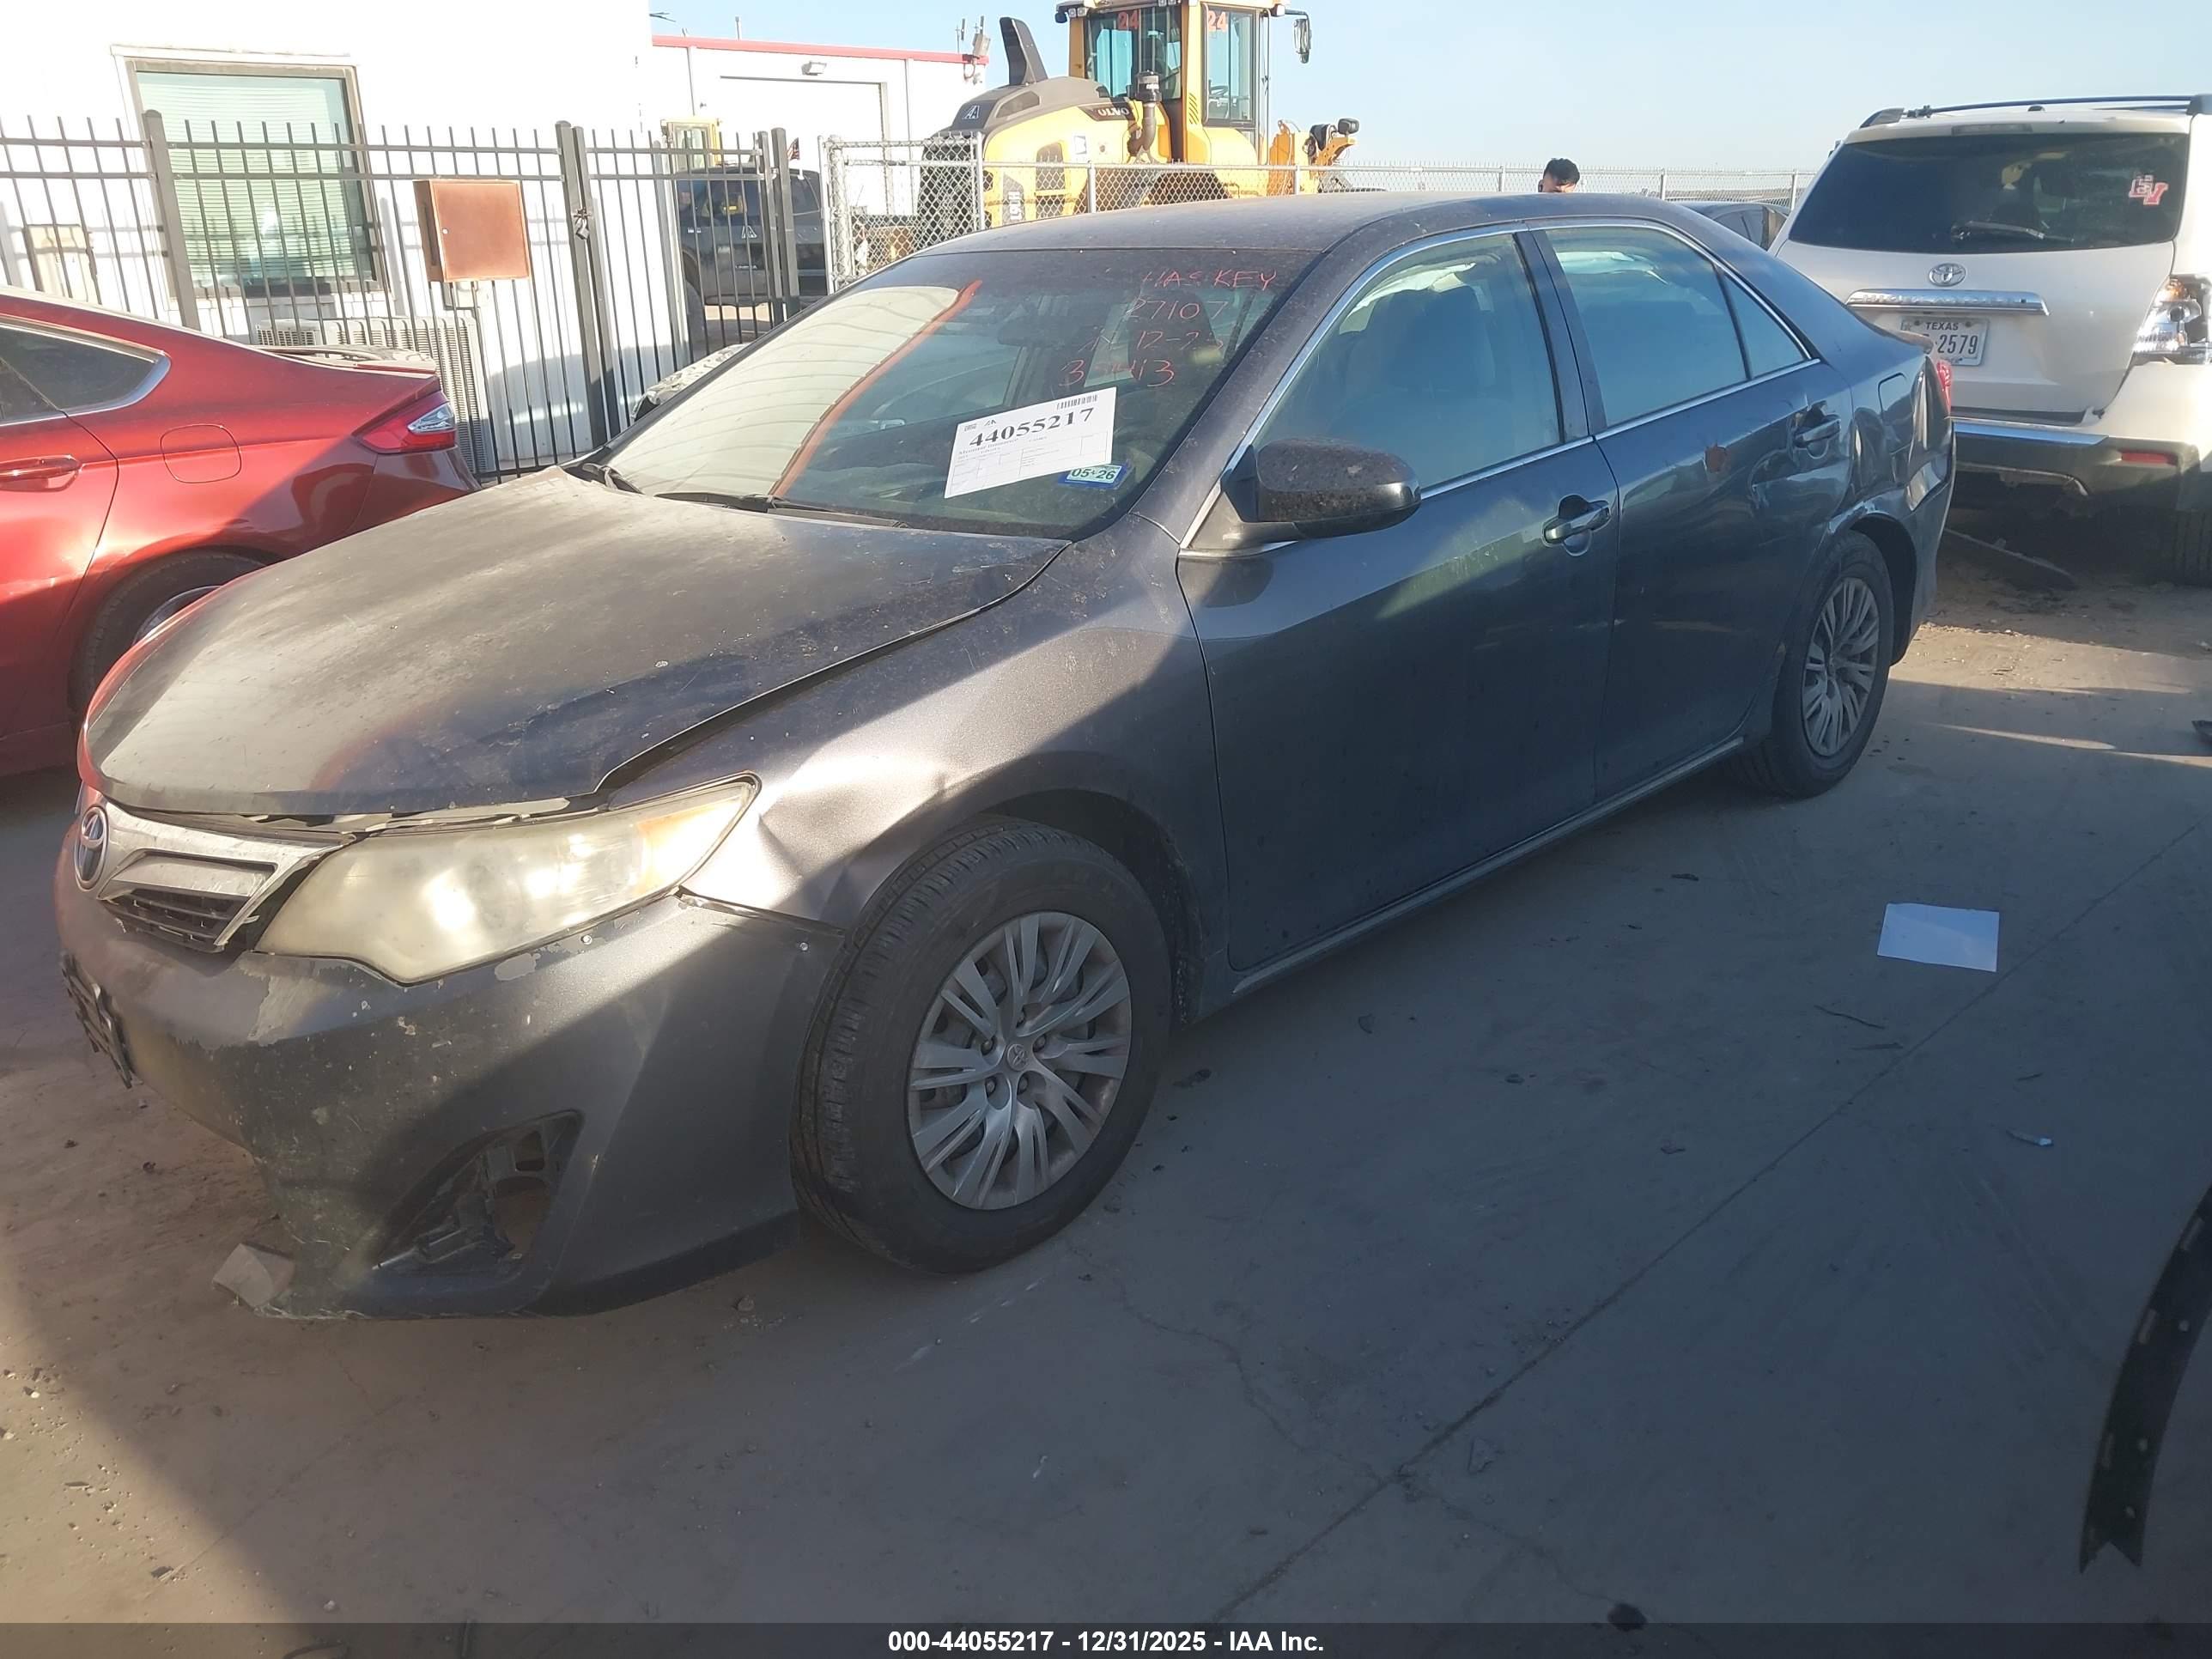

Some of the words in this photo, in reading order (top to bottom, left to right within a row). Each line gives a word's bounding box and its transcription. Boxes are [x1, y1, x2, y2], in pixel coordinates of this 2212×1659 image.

[1214, 270, 1277, 290] KEY
[1926, 322, 1959, 331] TEXAS
[1923, 334, 1978, 355] 2579
[969, 408, 1094, 447] 44055217
[1071, 468, 1091, 477] 05
[1096, 470, 1116, 480] 26
